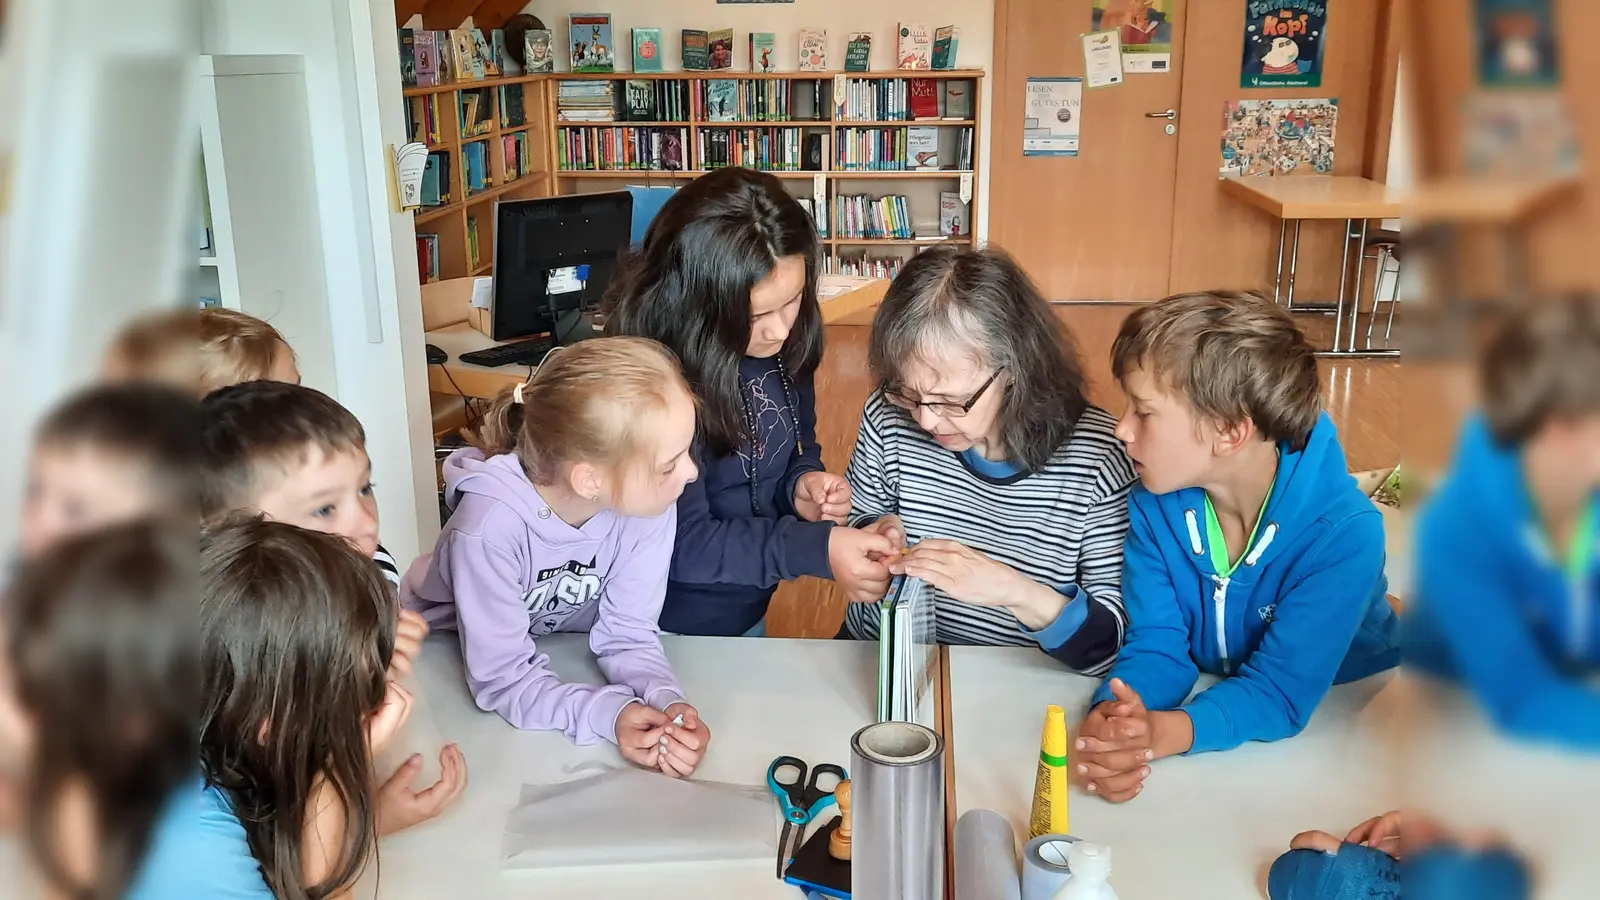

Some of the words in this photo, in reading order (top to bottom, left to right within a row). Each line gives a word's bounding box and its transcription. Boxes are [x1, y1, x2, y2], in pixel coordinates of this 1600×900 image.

[1263, 14, 1308, 37] Kopf
[630, 89, 649, 100] FAIR
[911, 87, 933, 97] Mut!
[631, 100, 649, 109] PLAY
[1062, 99, 1080, 107] TUN
